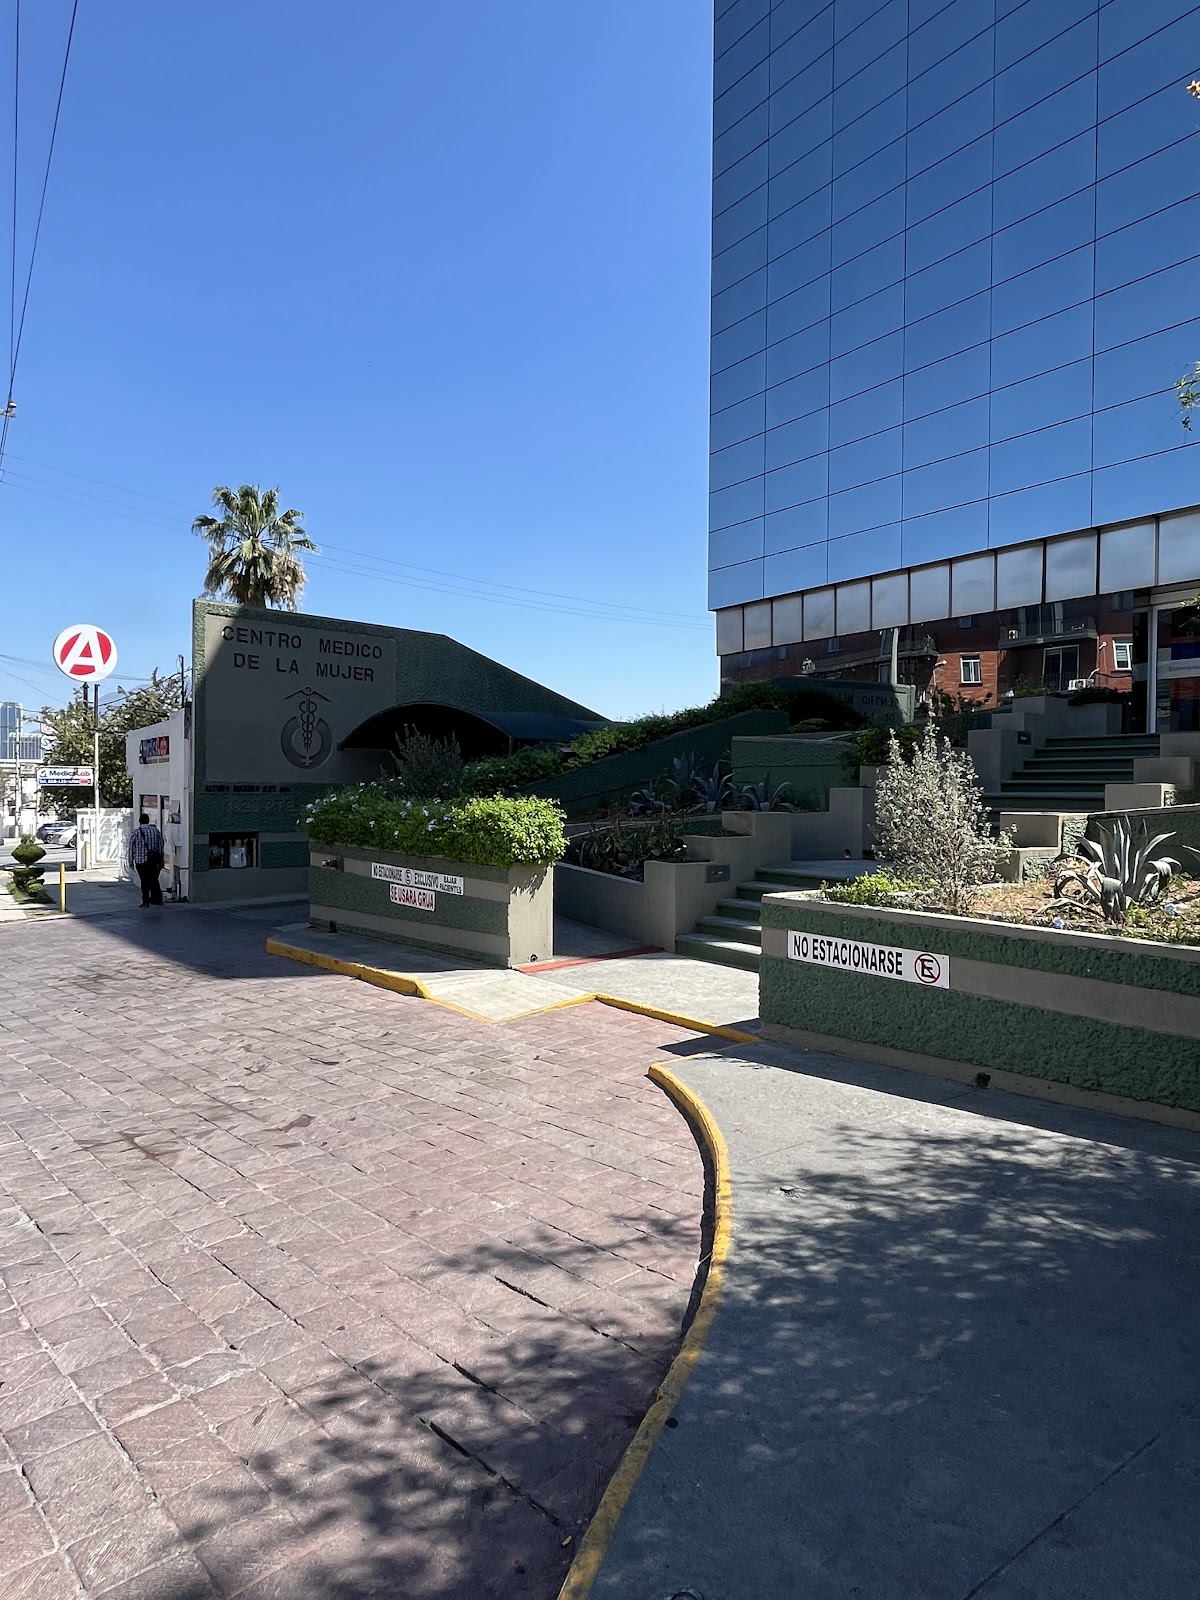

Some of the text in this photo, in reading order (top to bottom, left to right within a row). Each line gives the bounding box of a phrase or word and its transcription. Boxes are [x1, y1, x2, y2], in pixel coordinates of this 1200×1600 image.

[222, 625, 382, 659] CENTRO MEDICO
[233, 652, 374, 682] DE LA MUJER
[204, 784, 230, 793] ALTURA
[379, 866, 402, 882] ESTACIONARSE
[414, 872, 439, 889] EXCLUSIVO
[439, 883, 462, 894] PACIENTES
[443, 875, 457, 885] BAJAR
[390, 885, 434, 908] SE USARA GRUA
[793, 934, 903, 976] NO ESTACIONARSE
